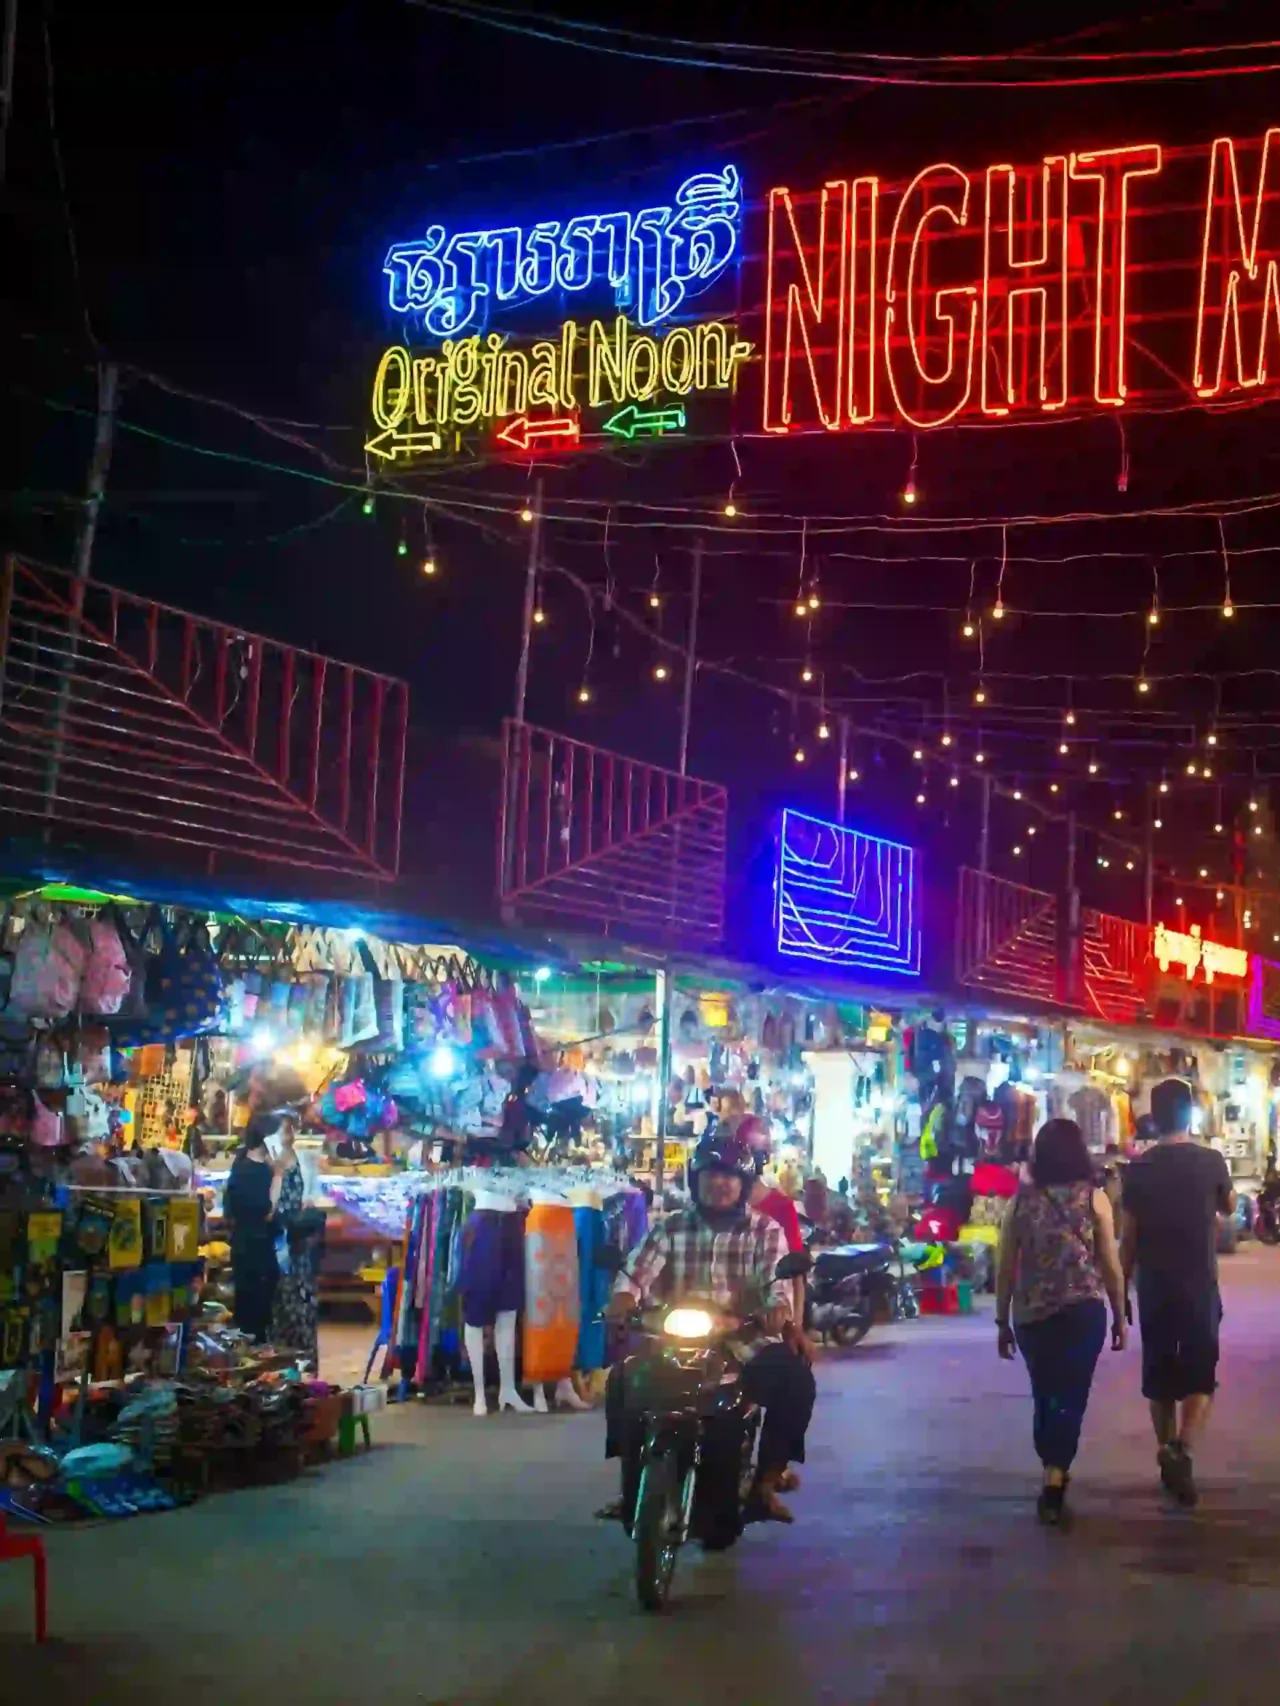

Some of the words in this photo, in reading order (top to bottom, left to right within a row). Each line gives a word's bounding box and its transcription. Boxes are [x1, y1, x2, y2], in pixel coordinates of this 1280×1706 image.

[372, 319, 578, 431] Original
[588, 315, 754, 407] Noon
[761, 143, 1163, 435] NIGHT
